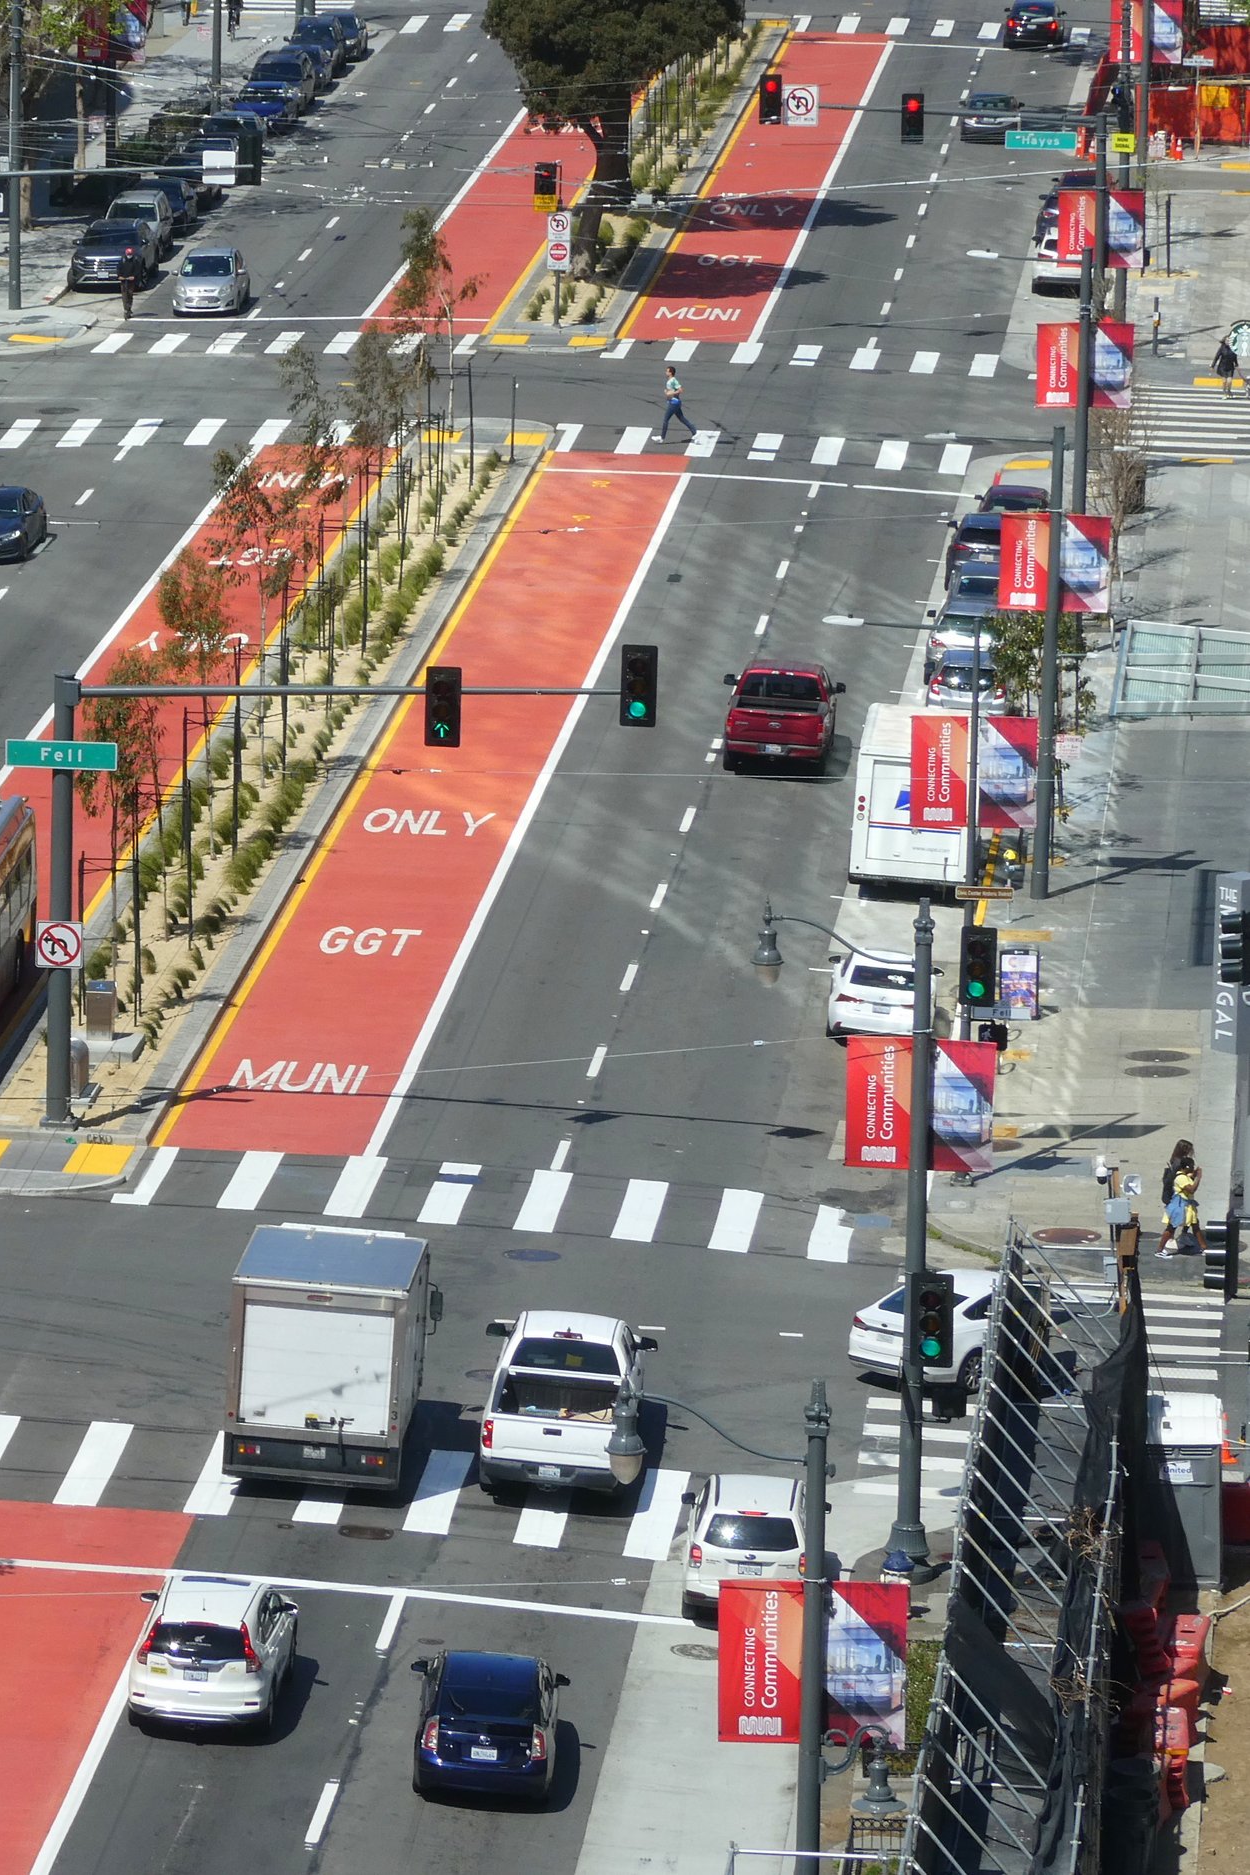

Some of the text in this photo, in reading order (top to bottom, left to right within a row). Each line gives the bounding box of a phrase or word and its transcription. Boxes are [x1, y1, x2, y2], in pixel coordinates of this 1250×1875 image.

[1021, 136, 1060, 147] Hayes
[709, 203, 794, 217] ONLY
[1077, 196, 1086, 251] Communities
[697, 254, 762, 267] GGT
[654, 306, 742, 321] MUNI
[1058, 327, 1068, 388] Communities
[1014, 540, 1023, 588] CONNECTING
[1024, 519, 1037, 588] Communities
[40, 747, 82, 763] Fell
[938, 722, 952, 803] Communities
[927, 747, 936, 802] CONNECTING
[363, 808, 497, 837] ONLY
[1219, 886, 1238, 903] THE
[319, 926, 422, 957] GGT
[1214, 904, 1238, 1040] MIGAL
[992, 1008, 1011, 1017] Fell
[228, 1058, 369, 1095] MUNI
[880, 1045, 895, 1140] Communities
[866, 1074, 877, 1139] CONNECTING
[391, 1411, 399, 1421] 3
[1163, 1465, 1192, 1474] United
[744, 1627, 756, 1708] CONNECTING
[761, 1590, 778, 1709] Communities
